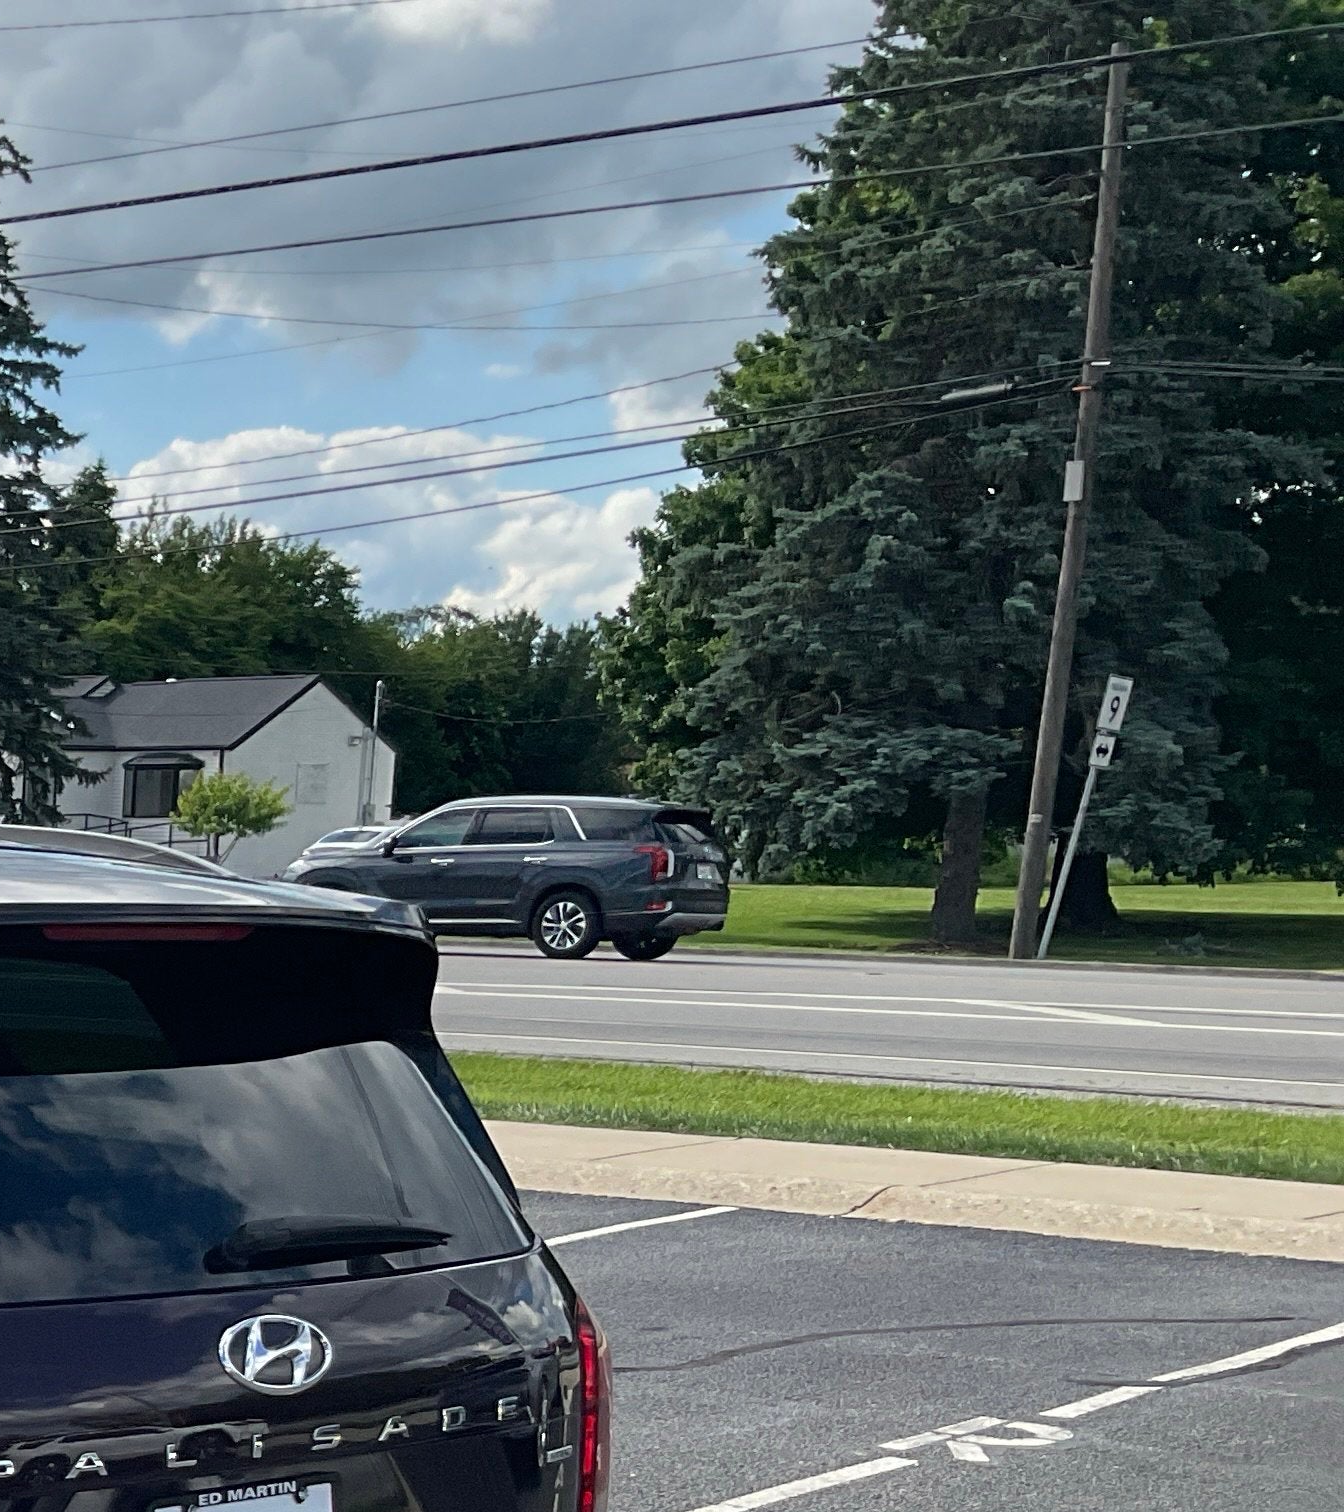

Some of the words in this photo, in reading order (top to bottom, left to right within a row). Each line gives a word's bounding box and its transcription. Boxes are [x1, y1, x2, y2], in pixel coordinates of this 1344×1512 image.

[1109, 695, 1121, 723] 9
[198, 1491, 223, 1507] ED
[227, 1480, 297, 1502] MARTIN
